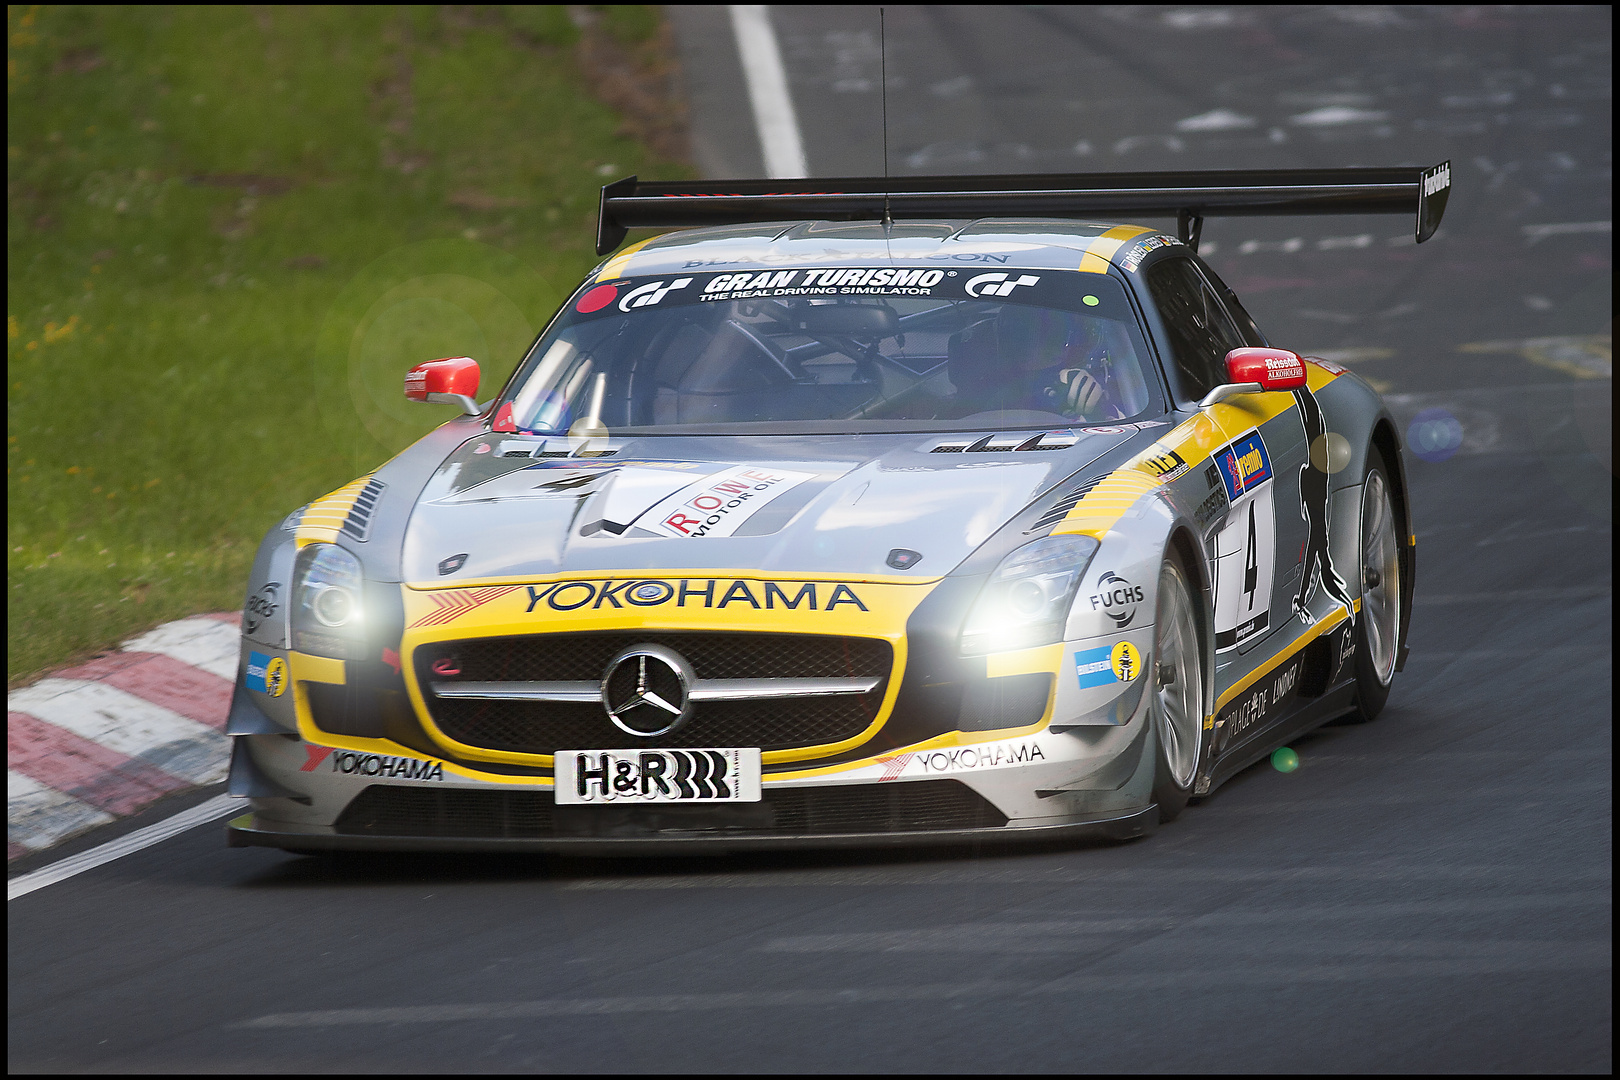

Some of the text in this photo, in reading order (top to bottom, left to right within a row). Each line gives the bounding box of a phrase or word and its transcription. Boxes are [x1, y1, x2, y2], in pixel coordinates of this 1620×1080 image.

[699, 286, 931, 302] THE REAL DRIVING SIMULATOR
[704, 270, 793, 295] GRAN
[691, 477, 785, 538] MOTOR OIL
[1244, 499, 1258, 612] 4
[525, 580, 870, 613] YOKOHAMA
[1089, 585, 1144, 611] FUCHS
[332, 749, 445, 782] YOKOHAMA
[917, 741, 1046, 773] YOKOHAMA
